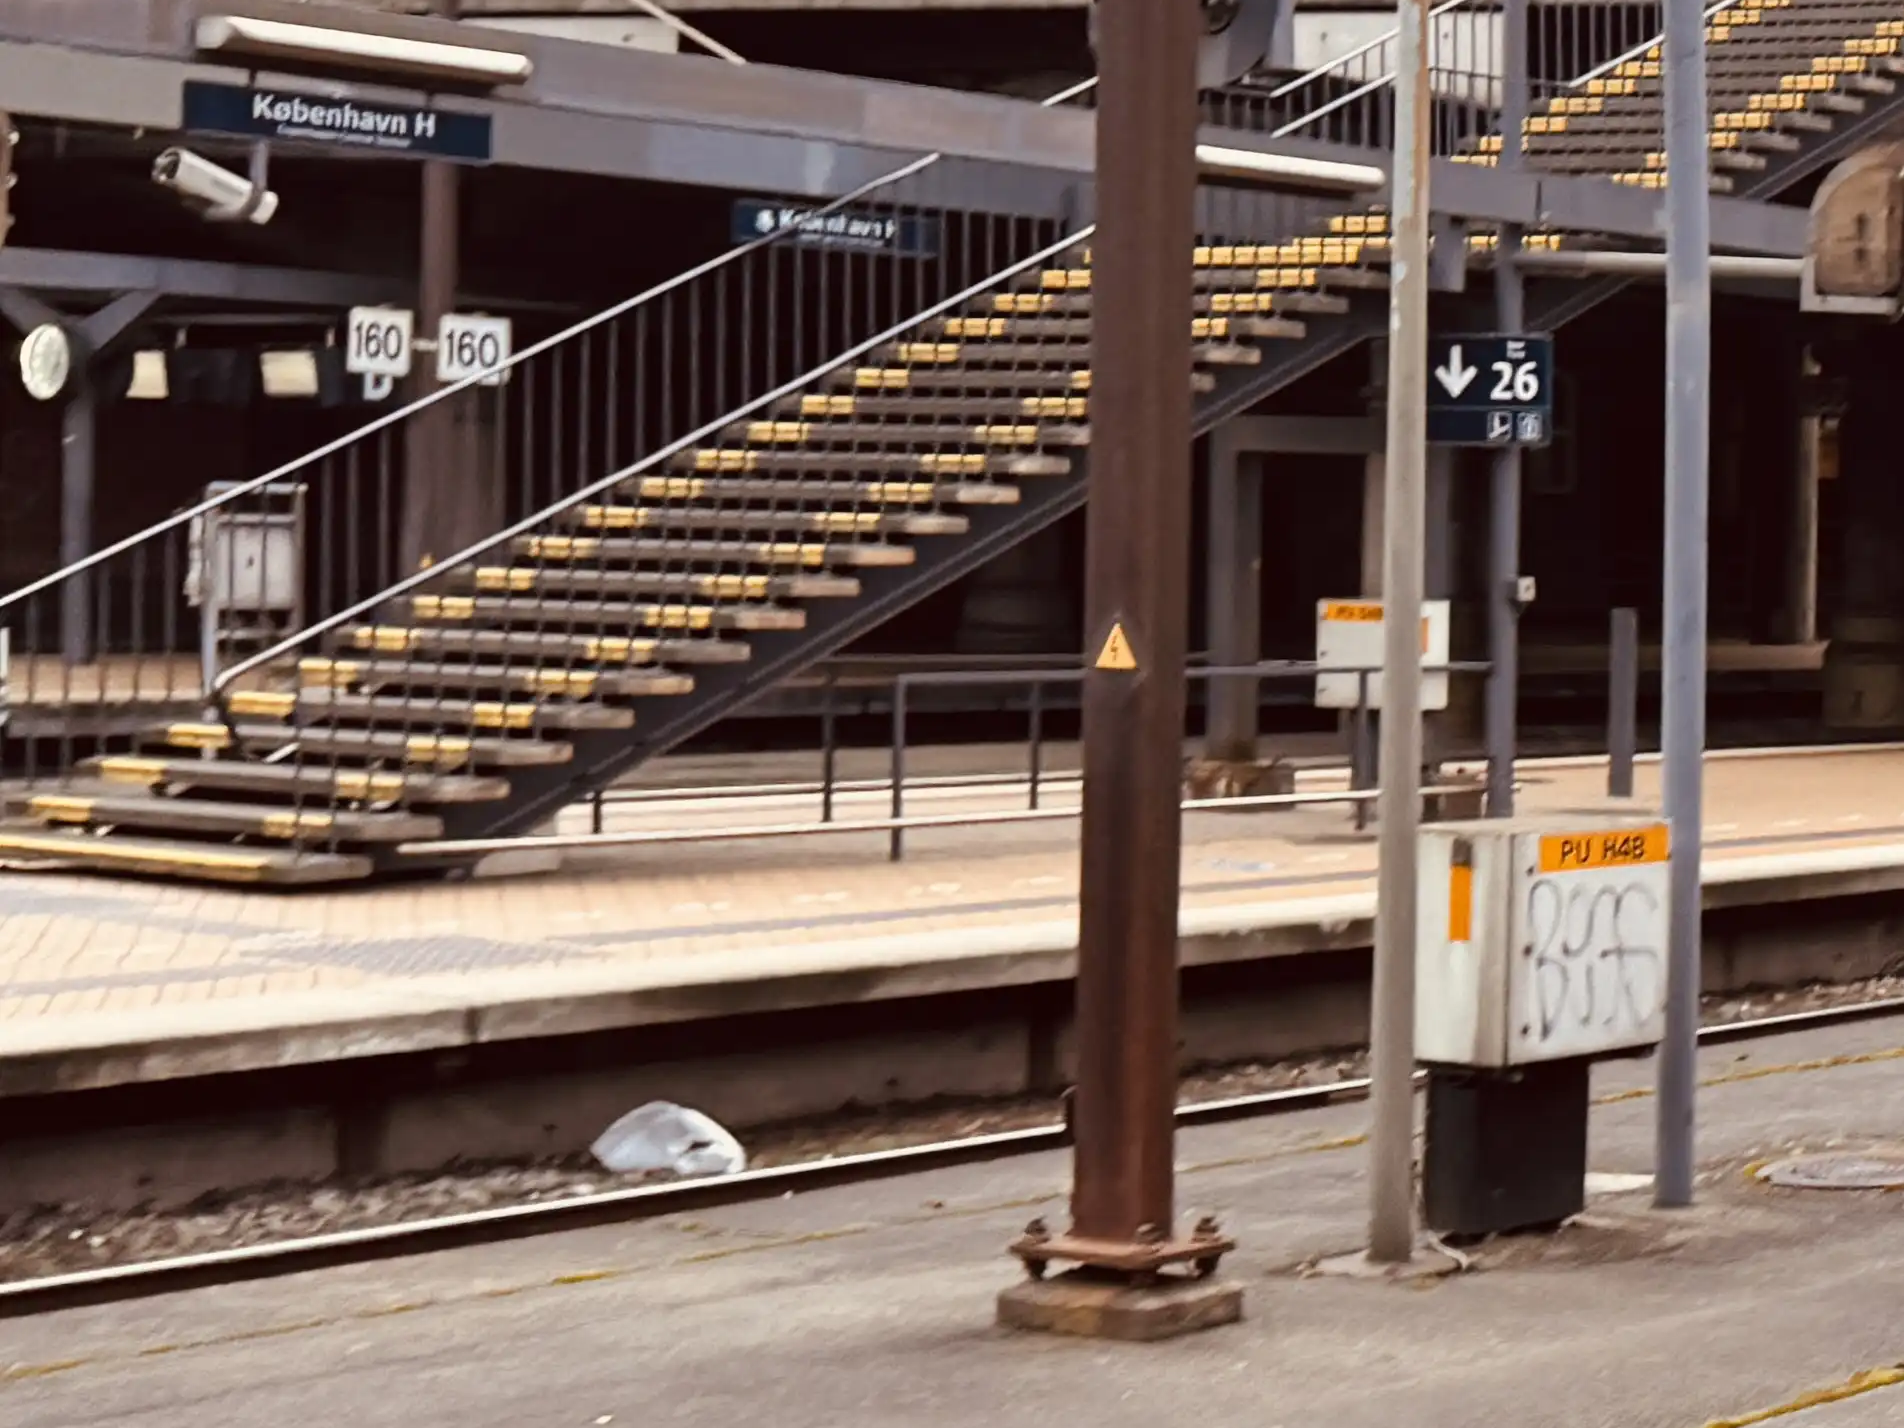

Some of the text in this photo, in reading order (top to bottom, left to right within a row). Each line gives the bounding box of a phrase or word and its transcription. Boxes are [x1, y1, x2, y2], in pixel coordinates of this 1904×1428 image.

[252, 93, 406, 134] København
[414, 112, 436, 138] H
[354, 320, 402, 360] 160
[447, 329, 499, 368] 160
[1490, 361, 1539, 401] 26
[1561, 839, 1591, 866] PU
